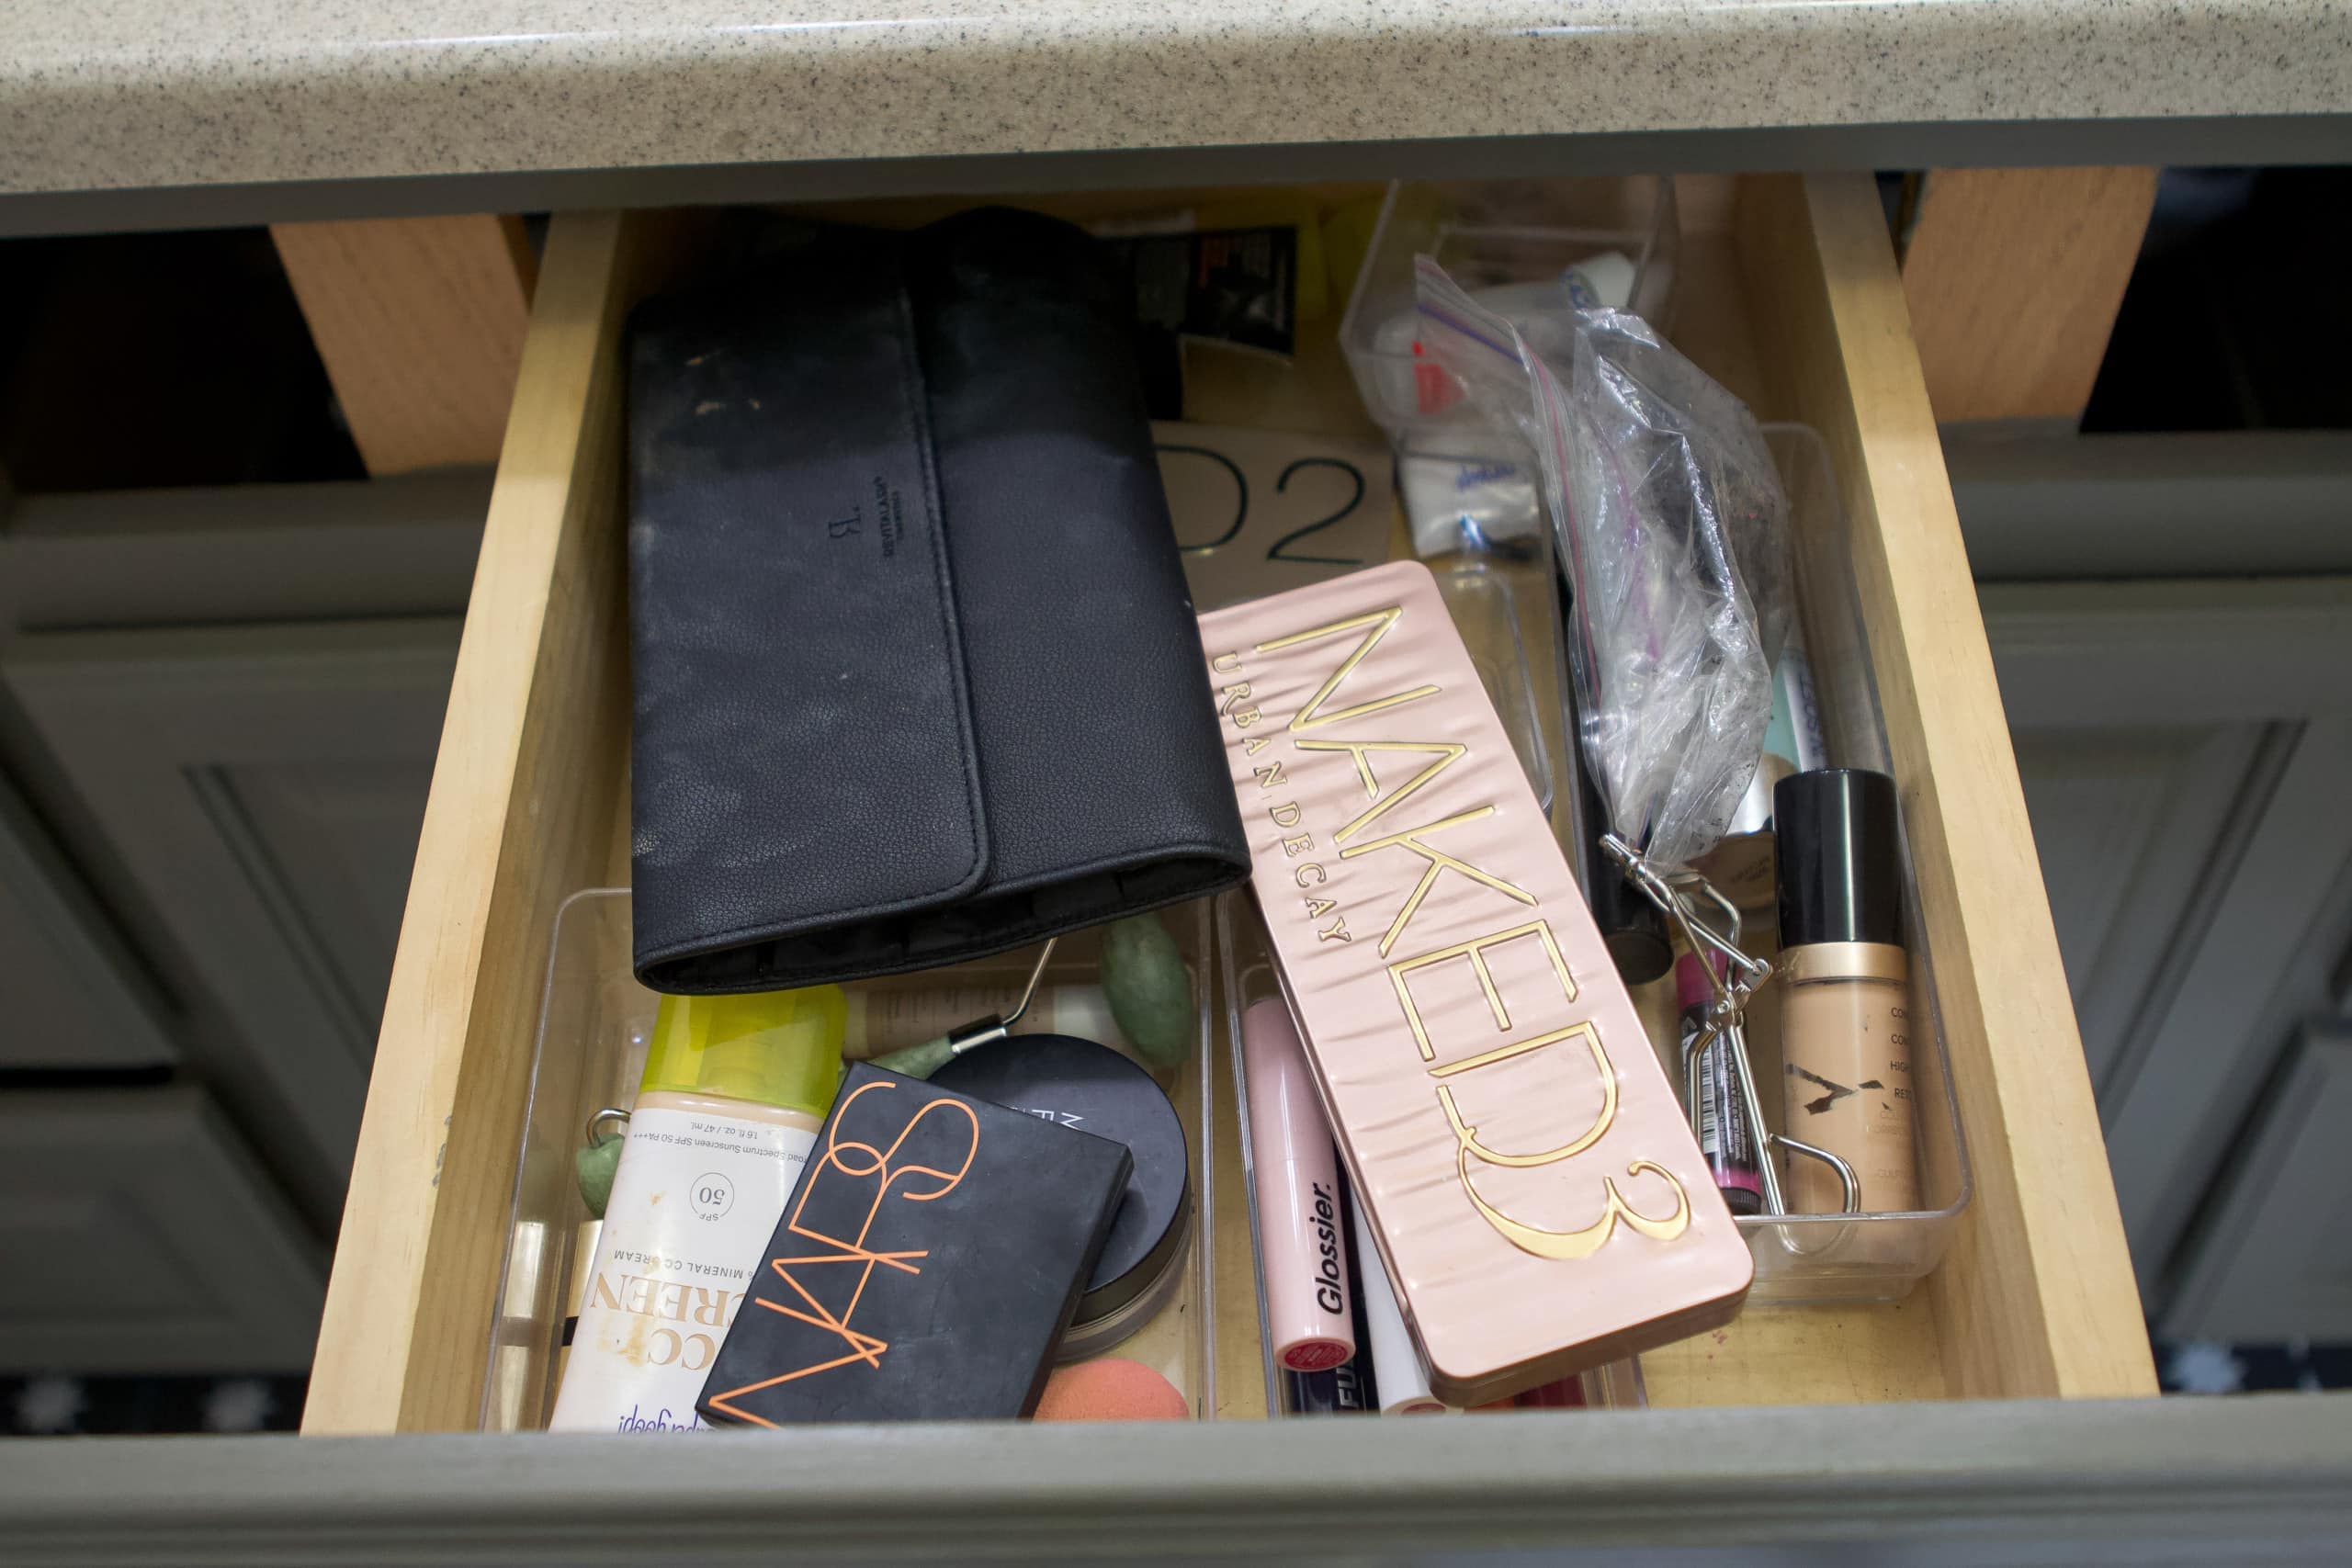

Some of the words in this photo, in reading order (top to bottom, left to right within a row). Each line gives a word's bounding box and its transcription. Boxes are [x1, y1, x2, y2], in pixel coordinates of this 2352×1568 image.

[1212, 652, 1286, 788] URBAN
[1270, 801, 1352, 942] DECAY
[704, 1123, 716, 1133] 47
[661, 1133, 673, 1144] 50
[674, 1135, 693, 1147] SPF
[694, 1138, 741, 1154] Sunscreen
[742, 1145, 786, 1160] Spectrum
[788, 1153, 808, 1163] road
[699, 1187, 726, 1206] 50
[699, 1213, 719, 1222] SPF
[1309, 1182, 1344, 1315] Glossier.
[665, 1258, 683, 1270] CC
[687, 1262, 744, 1280] MINERAL
[590, 1270, 747, 1327] REEN
[647, 1328, 716, 1371] CC
